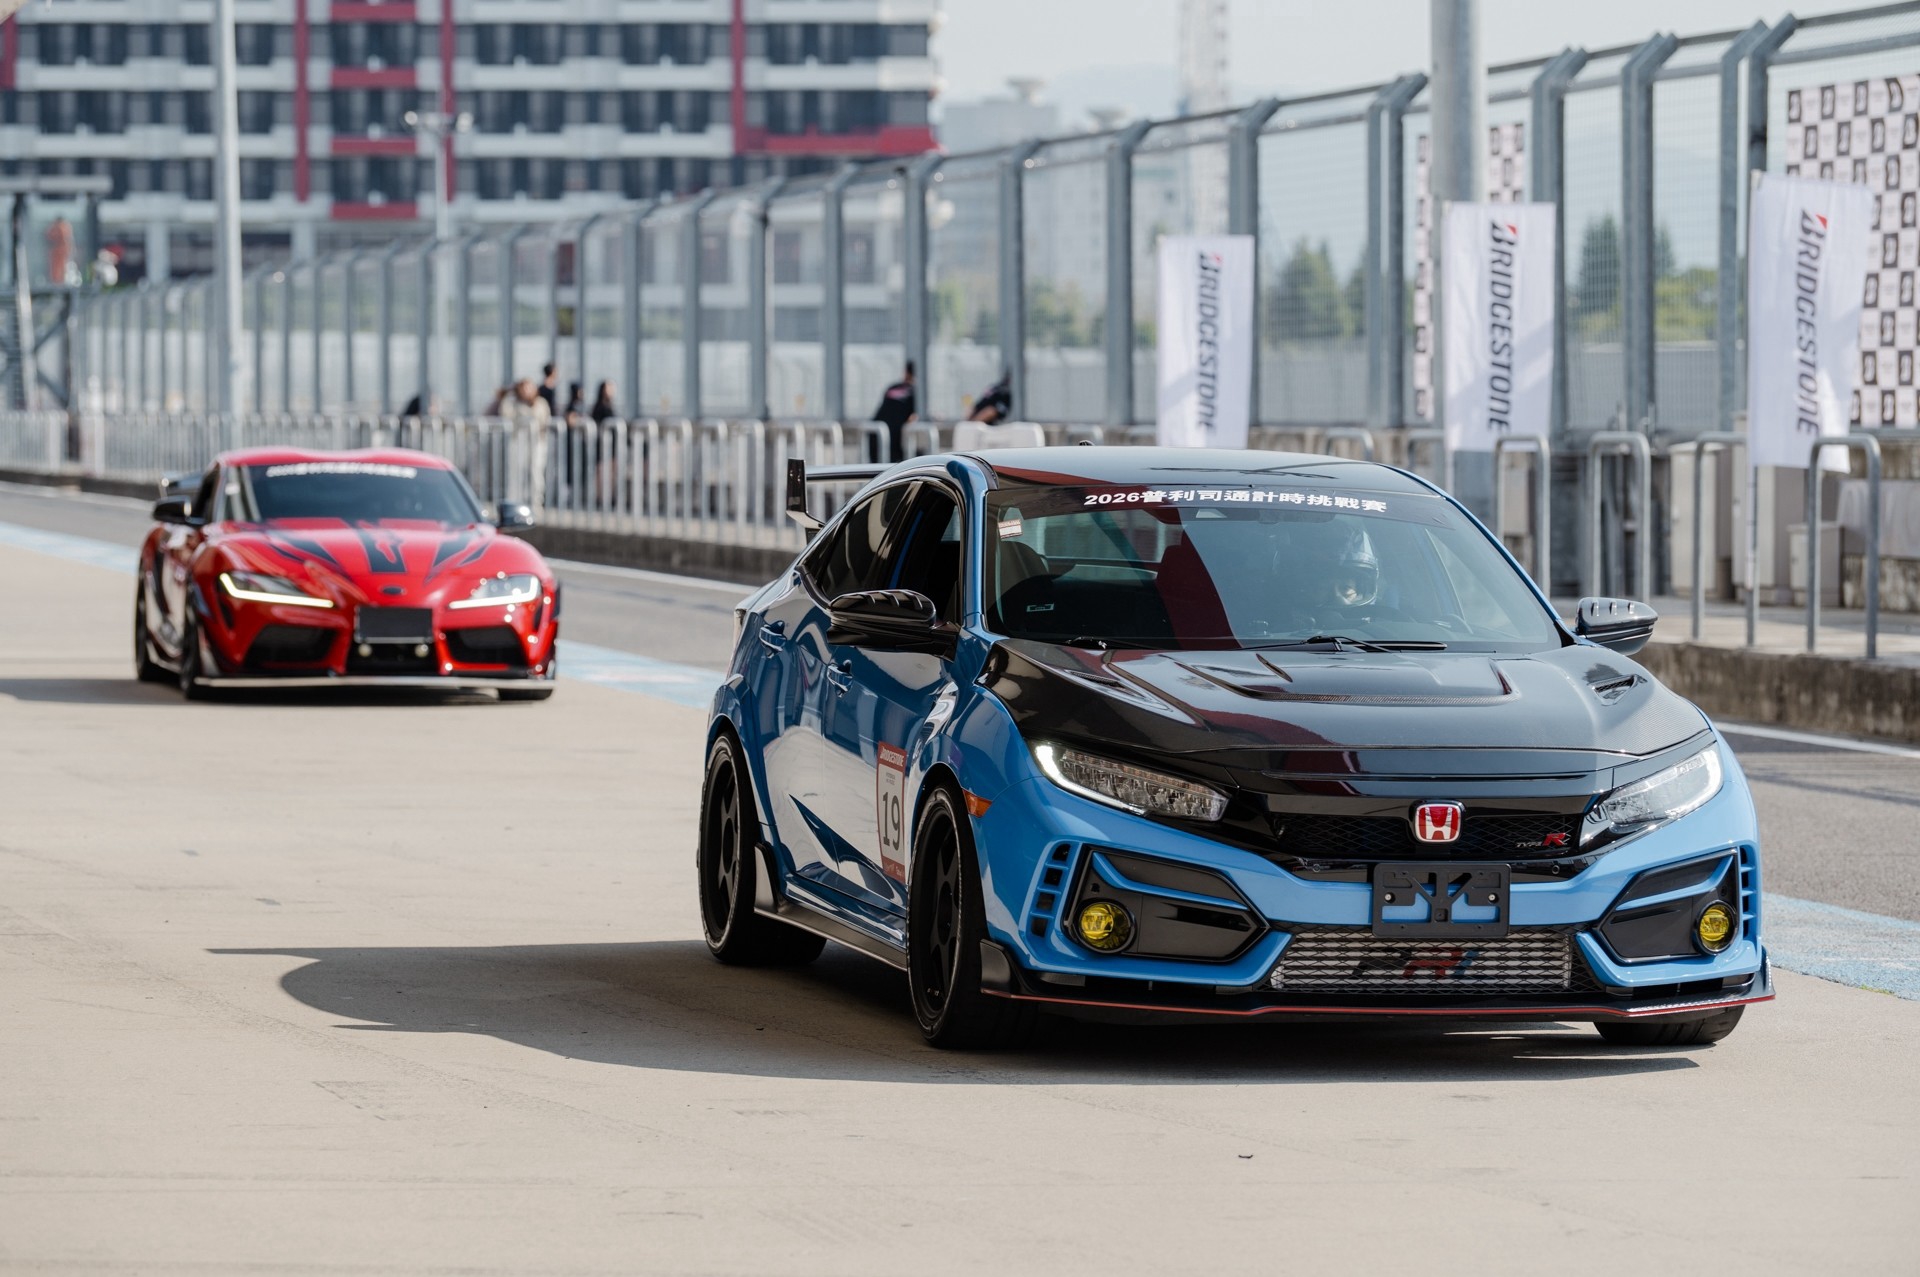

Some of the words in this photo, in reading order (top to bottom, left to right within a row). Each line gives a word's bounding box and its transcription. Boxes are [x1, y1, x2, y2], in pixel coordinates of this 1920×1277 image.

[1199, 252, 1223, 431] BRIDGESTONE
[1488, 221, 1518, 432] BRIDGESTONE
[1796, 210, 1828, 434] BRIDGESTONE
[1083, 489, 1387, 513] 2026普利司通計時挑戰賽
[882, 792, 901, 851] 19
[1542, 832, 1567, 847] R
